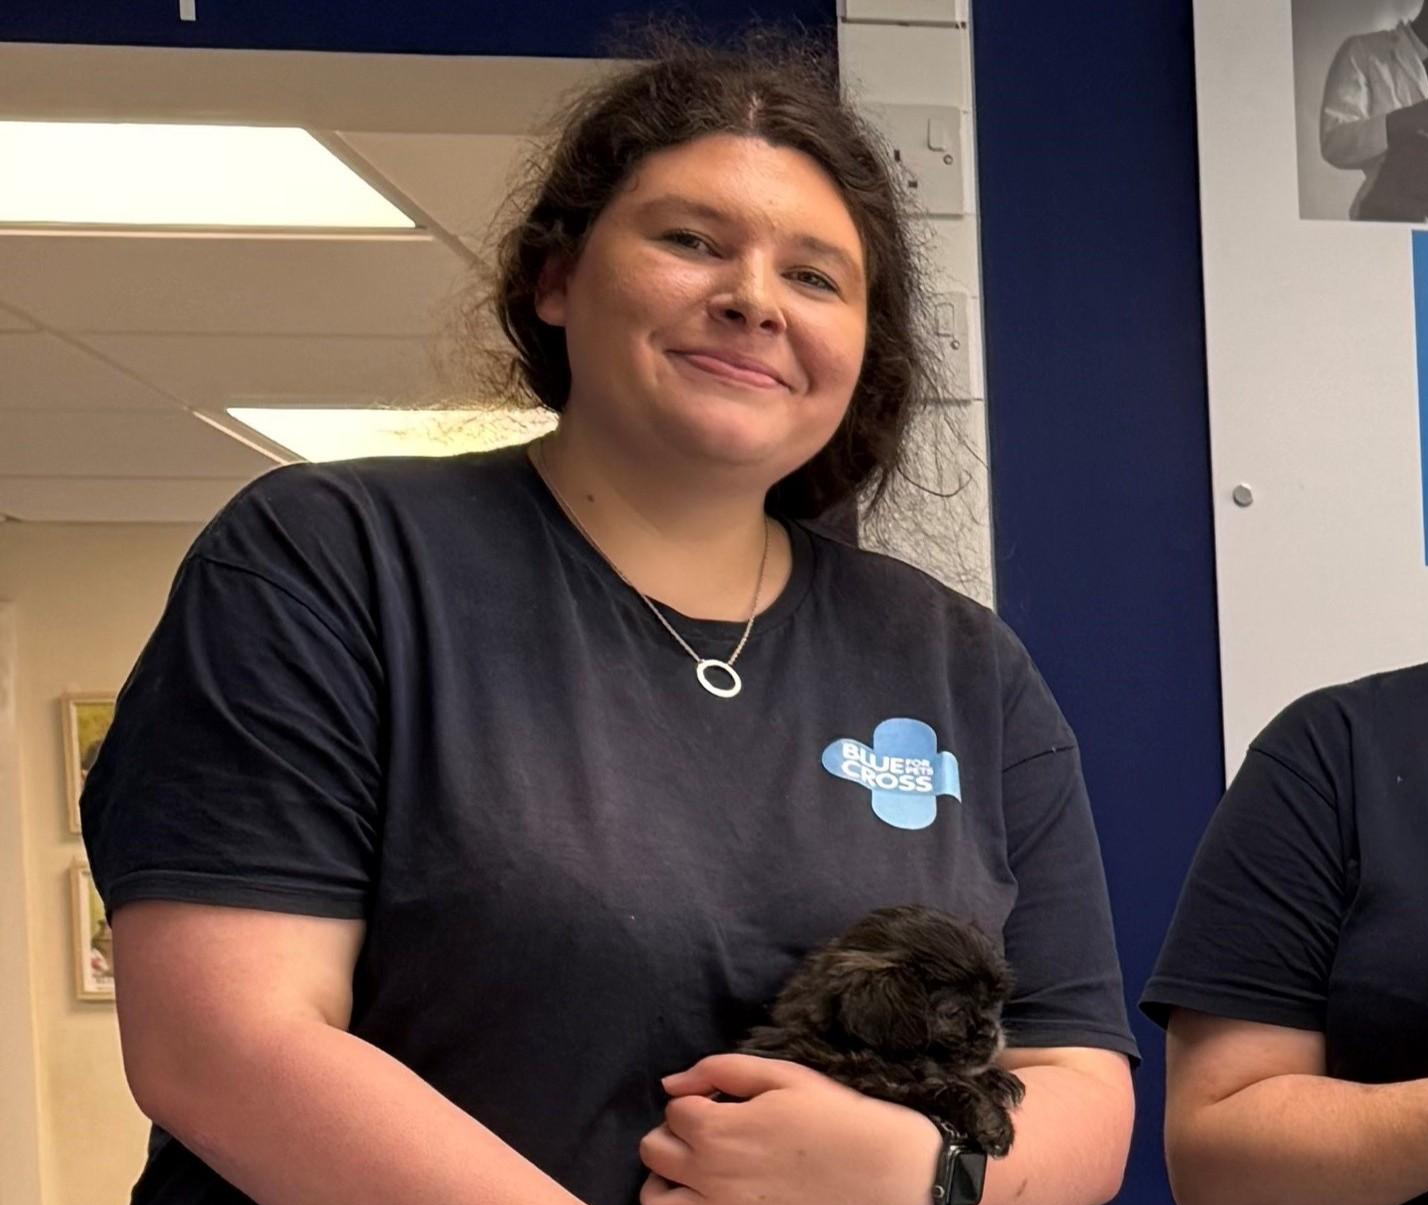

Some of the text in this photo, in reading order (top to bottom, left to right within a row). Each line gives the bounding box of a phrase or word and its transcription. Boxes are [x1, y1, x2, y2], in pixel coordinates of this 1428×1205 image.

[842, 743, 930, 774] BLUE FOR
[905, 766, 934, 776] PETS
[841, 761, 933, 792] CROSS
